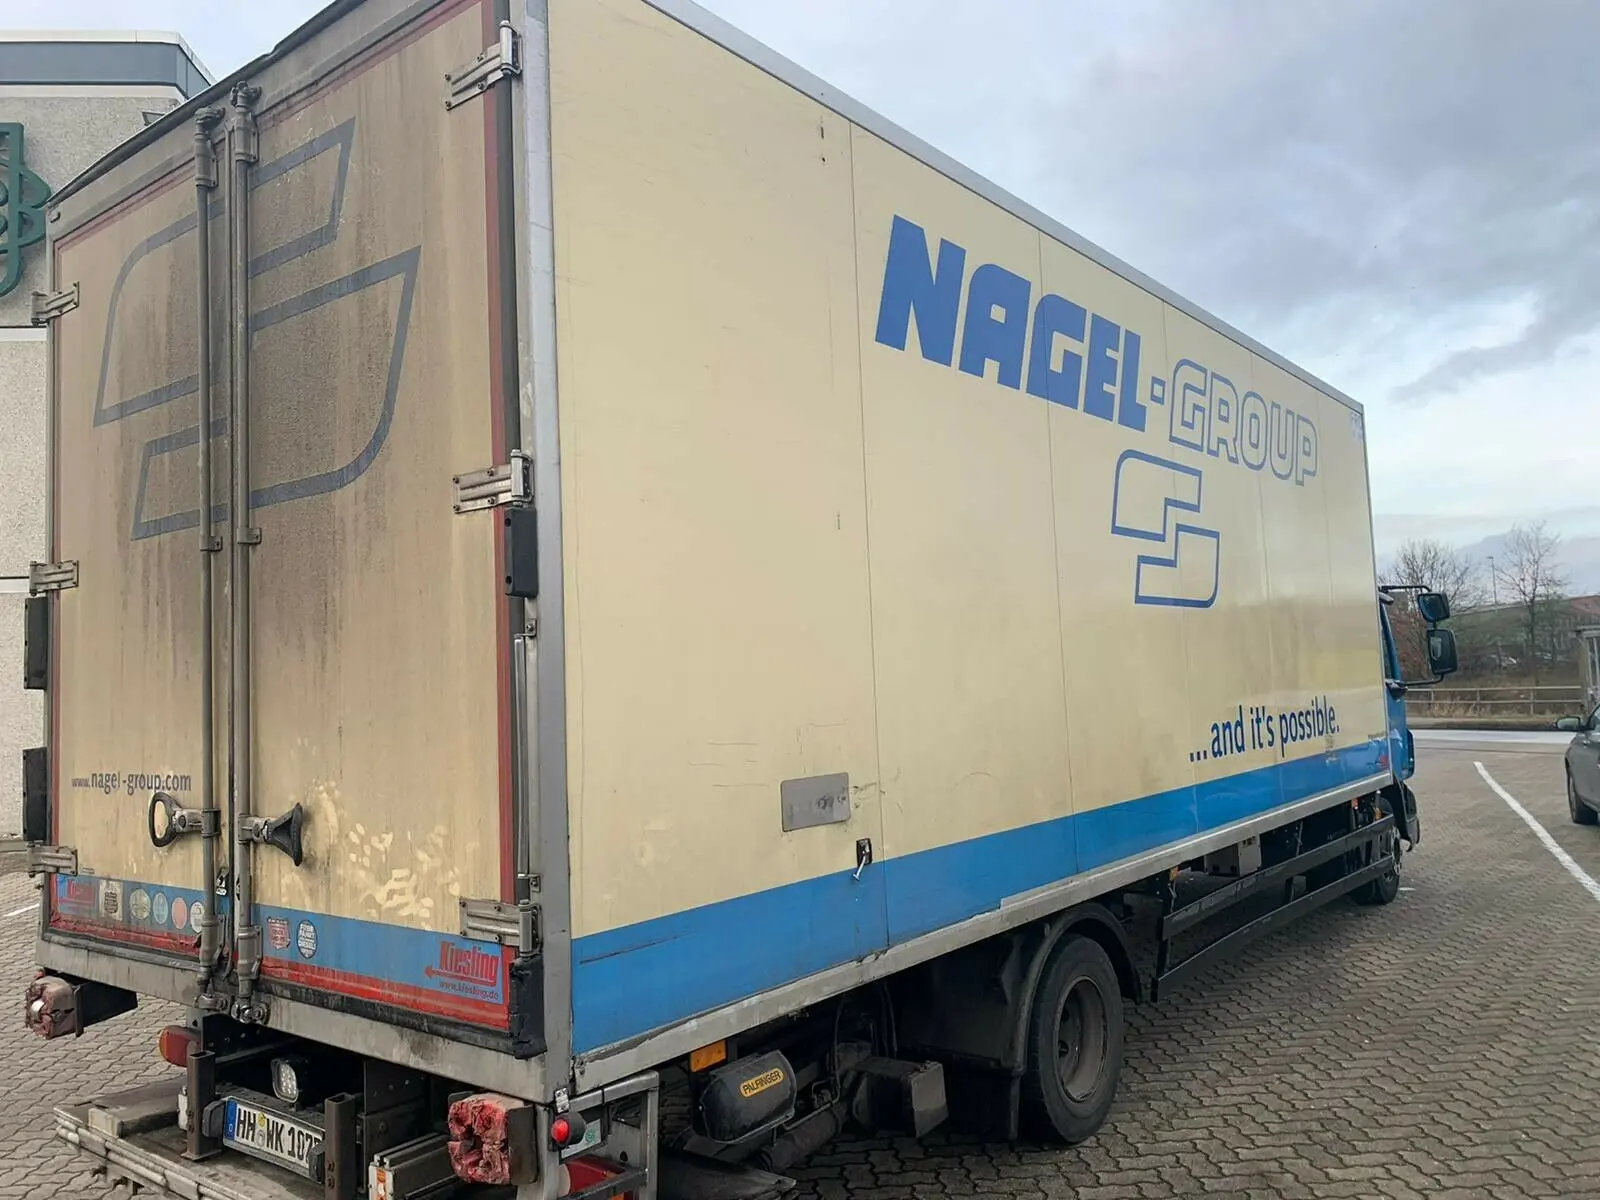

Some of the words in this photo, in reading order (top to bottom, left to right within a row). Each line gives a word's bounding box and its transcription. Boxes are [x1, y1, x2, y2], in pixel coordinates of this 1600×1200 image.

[875, 214, 1318, 486] NAGEL-GROUP
[1250, 706, 1275, 749] it's
[1279, 695, 1340, 757] possible.
[440, 941, 499, 984] Kiesling
[742, 1070, 781, 1095] PALFINGER
